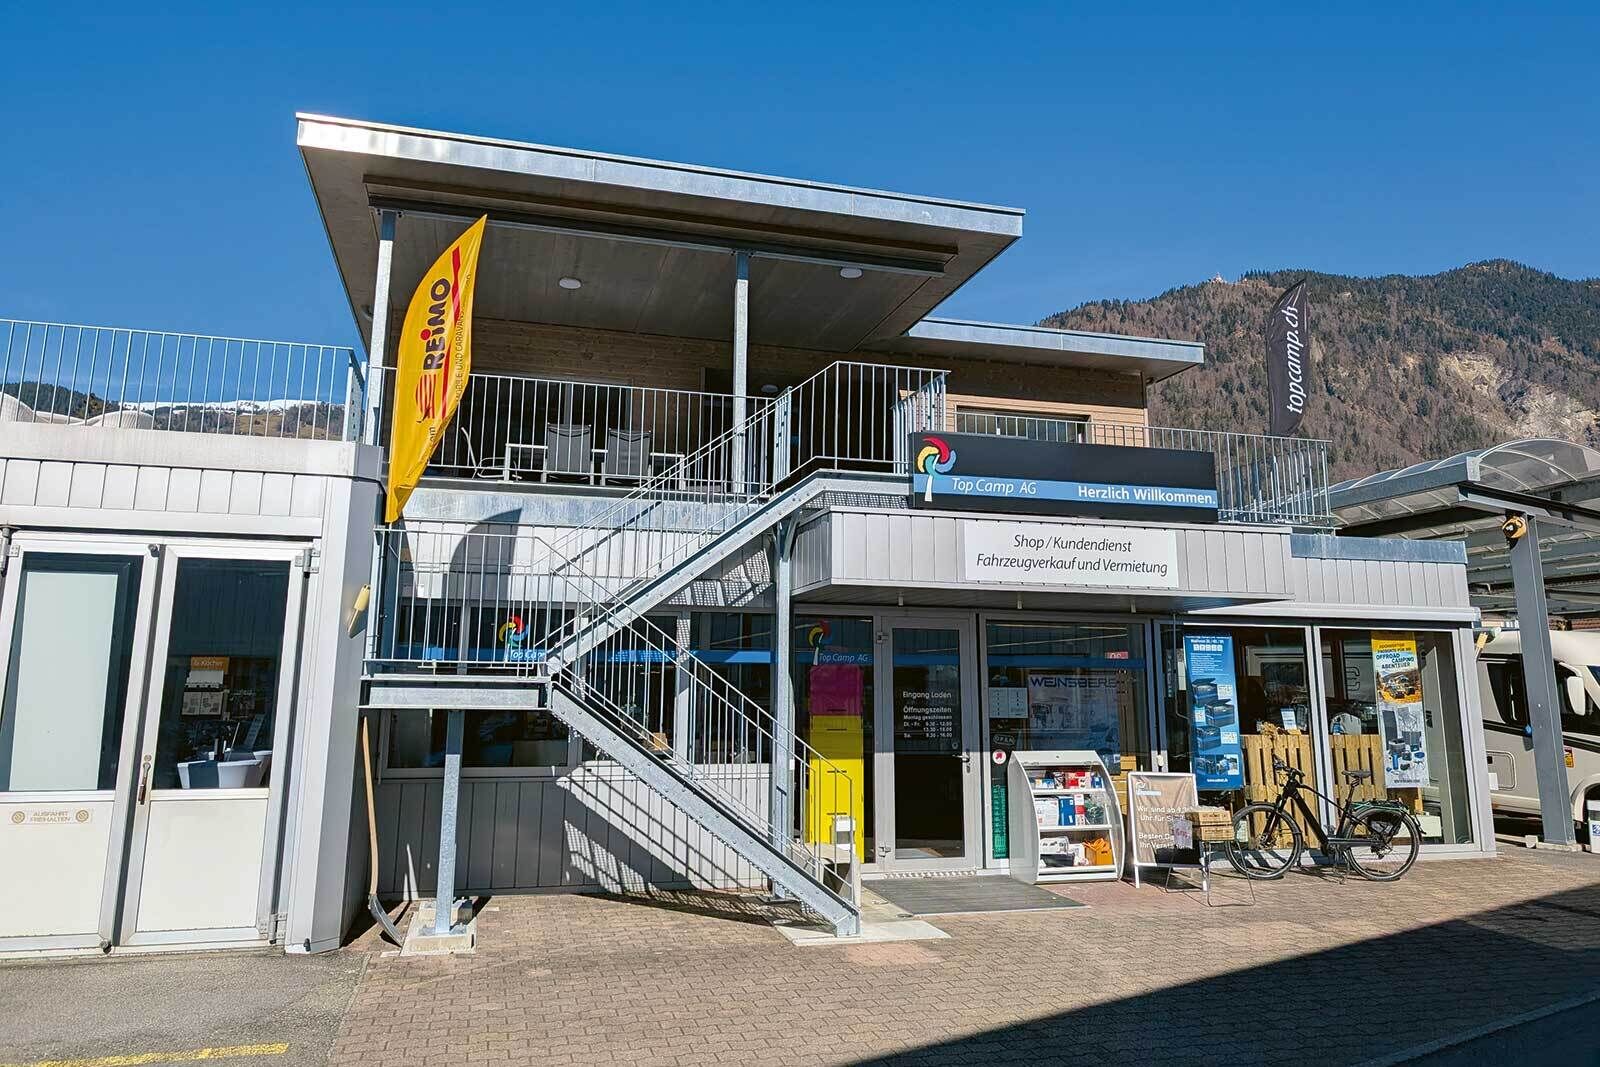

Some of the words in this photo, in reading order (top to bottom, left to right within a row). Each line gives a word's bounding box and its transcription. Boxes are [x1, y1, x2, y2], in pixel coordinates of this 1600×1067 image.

[455, 353, 463, 371] UND
[1282, 305, 1306, 414] topcamp.ch
[952, 477, 974, 495] Top
[975, 479, 1014, 497] Camp
[1019, 481, 1037, 495] AG
[1078, 485, 1130, 500] Herzlich
[1133, 488, 1216, 504] Willkommen.
[1014, 534, 1044, 551] Shop
[1053, 536, 1132, 552] Kundendienst
[976, 553, 1078, 572] Fahrzeugverkauf
[1077, 556, 1100, 571] und
[1102, 558, 1168, 577] Vermietung
[819, 653, 831, 662] Top
[832, 653, 855, 662] Camp
[857, 653, 869, 662] AG
[903, 691, 930, 700] Eingang
[903, 706, 952, 714] Öffnungszeiten
[1138, 832, 1163, 840] Besten
